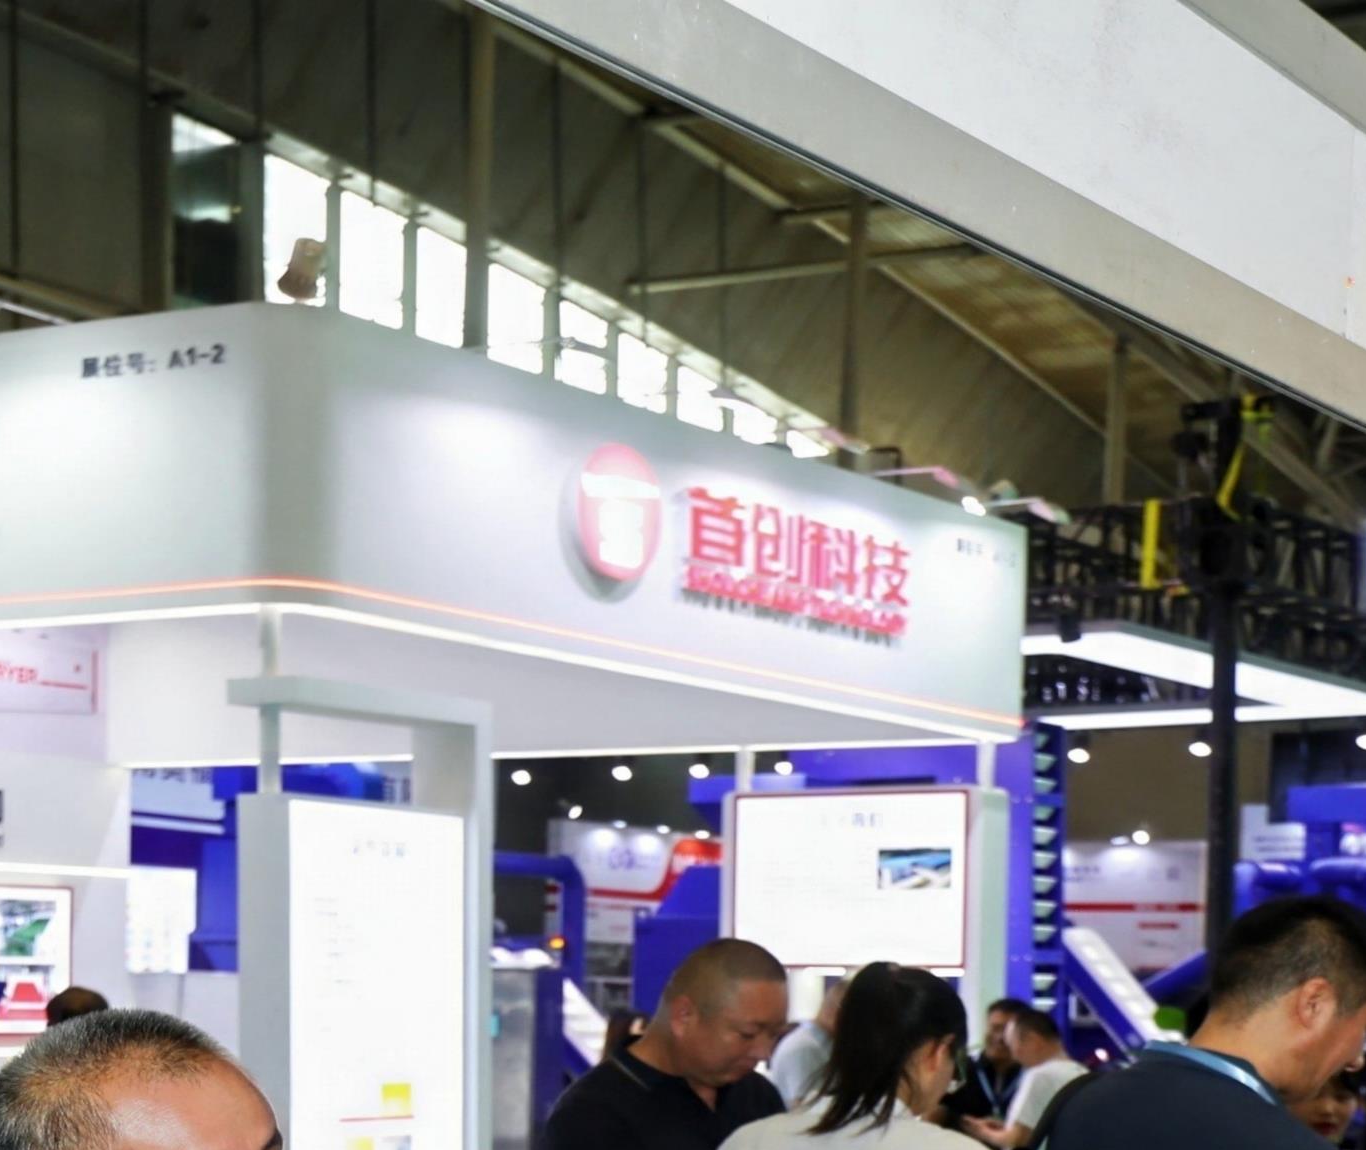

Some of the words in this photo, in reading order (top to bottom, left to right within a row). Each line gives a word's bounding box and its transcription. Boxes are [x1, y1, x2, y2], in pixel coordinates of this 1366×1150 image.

[168, 342, 226, 369] A1-2
[686, 487, 912, 607] 首创科技
